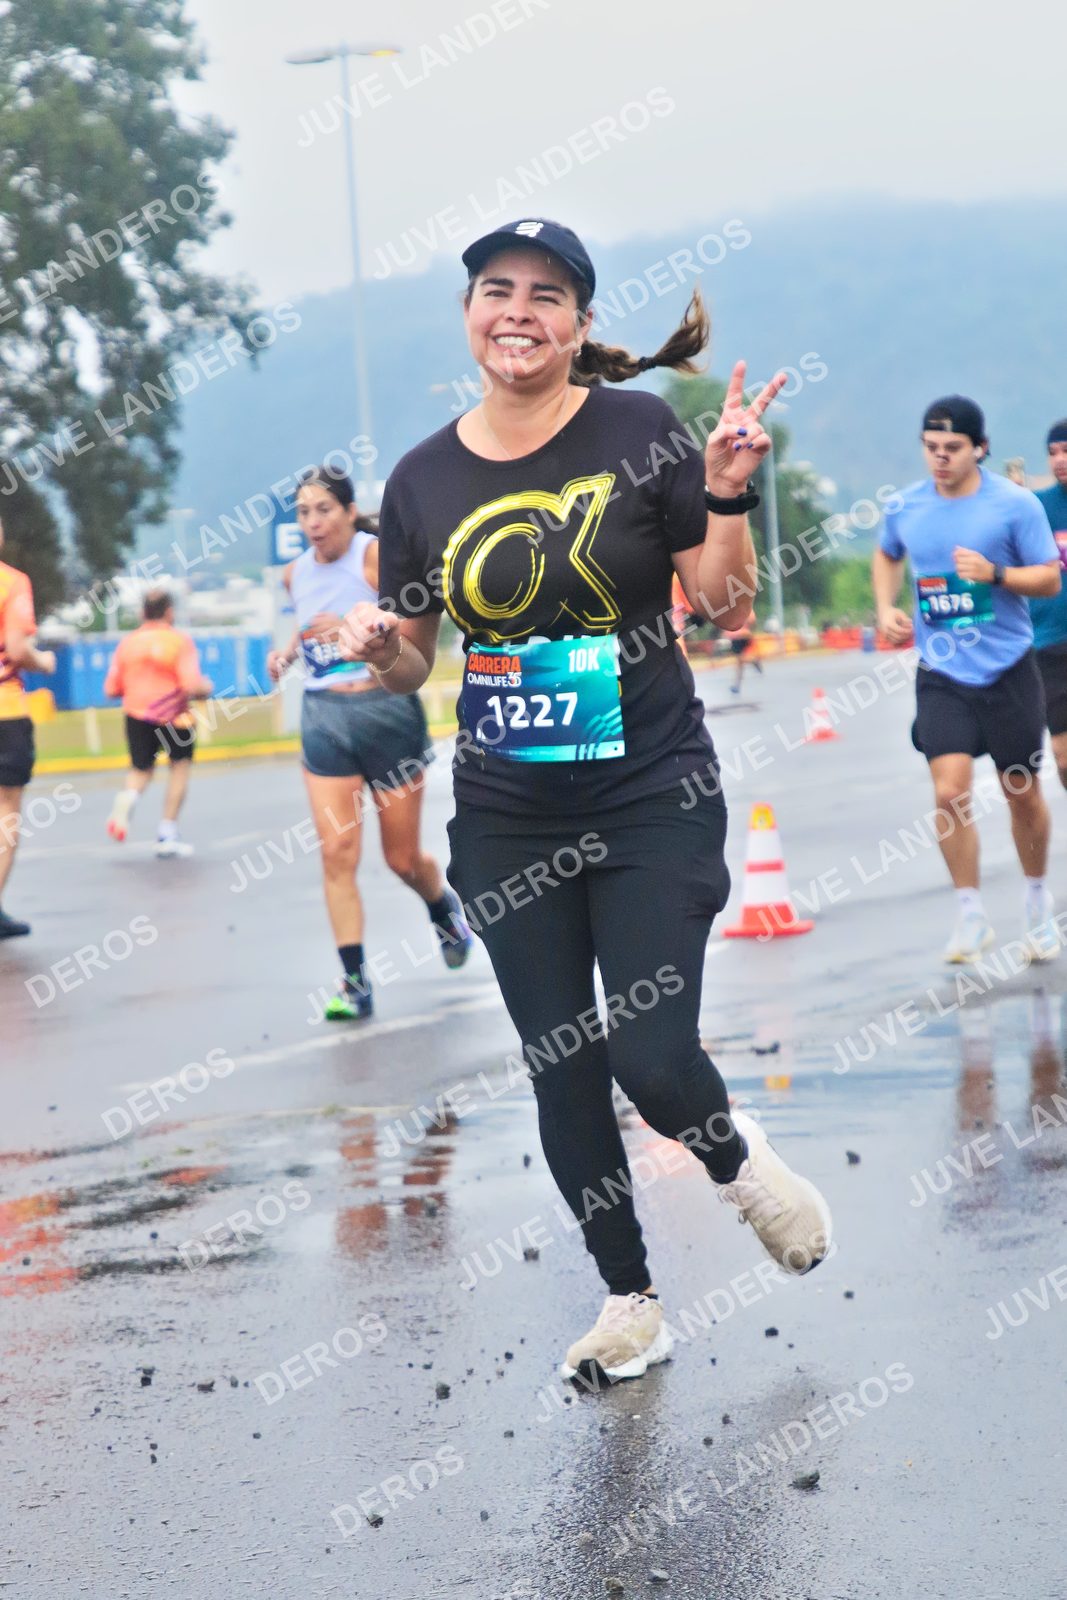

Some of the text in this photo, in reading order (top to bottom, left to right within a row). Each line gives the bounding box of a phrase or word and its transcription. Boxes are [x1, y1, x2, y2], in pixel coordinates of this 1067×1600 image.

[928, 592, 975, 615] 1676
[468, 647, 600, 675] CARRERA 10K
[487, 692, 578, 728] 1227
